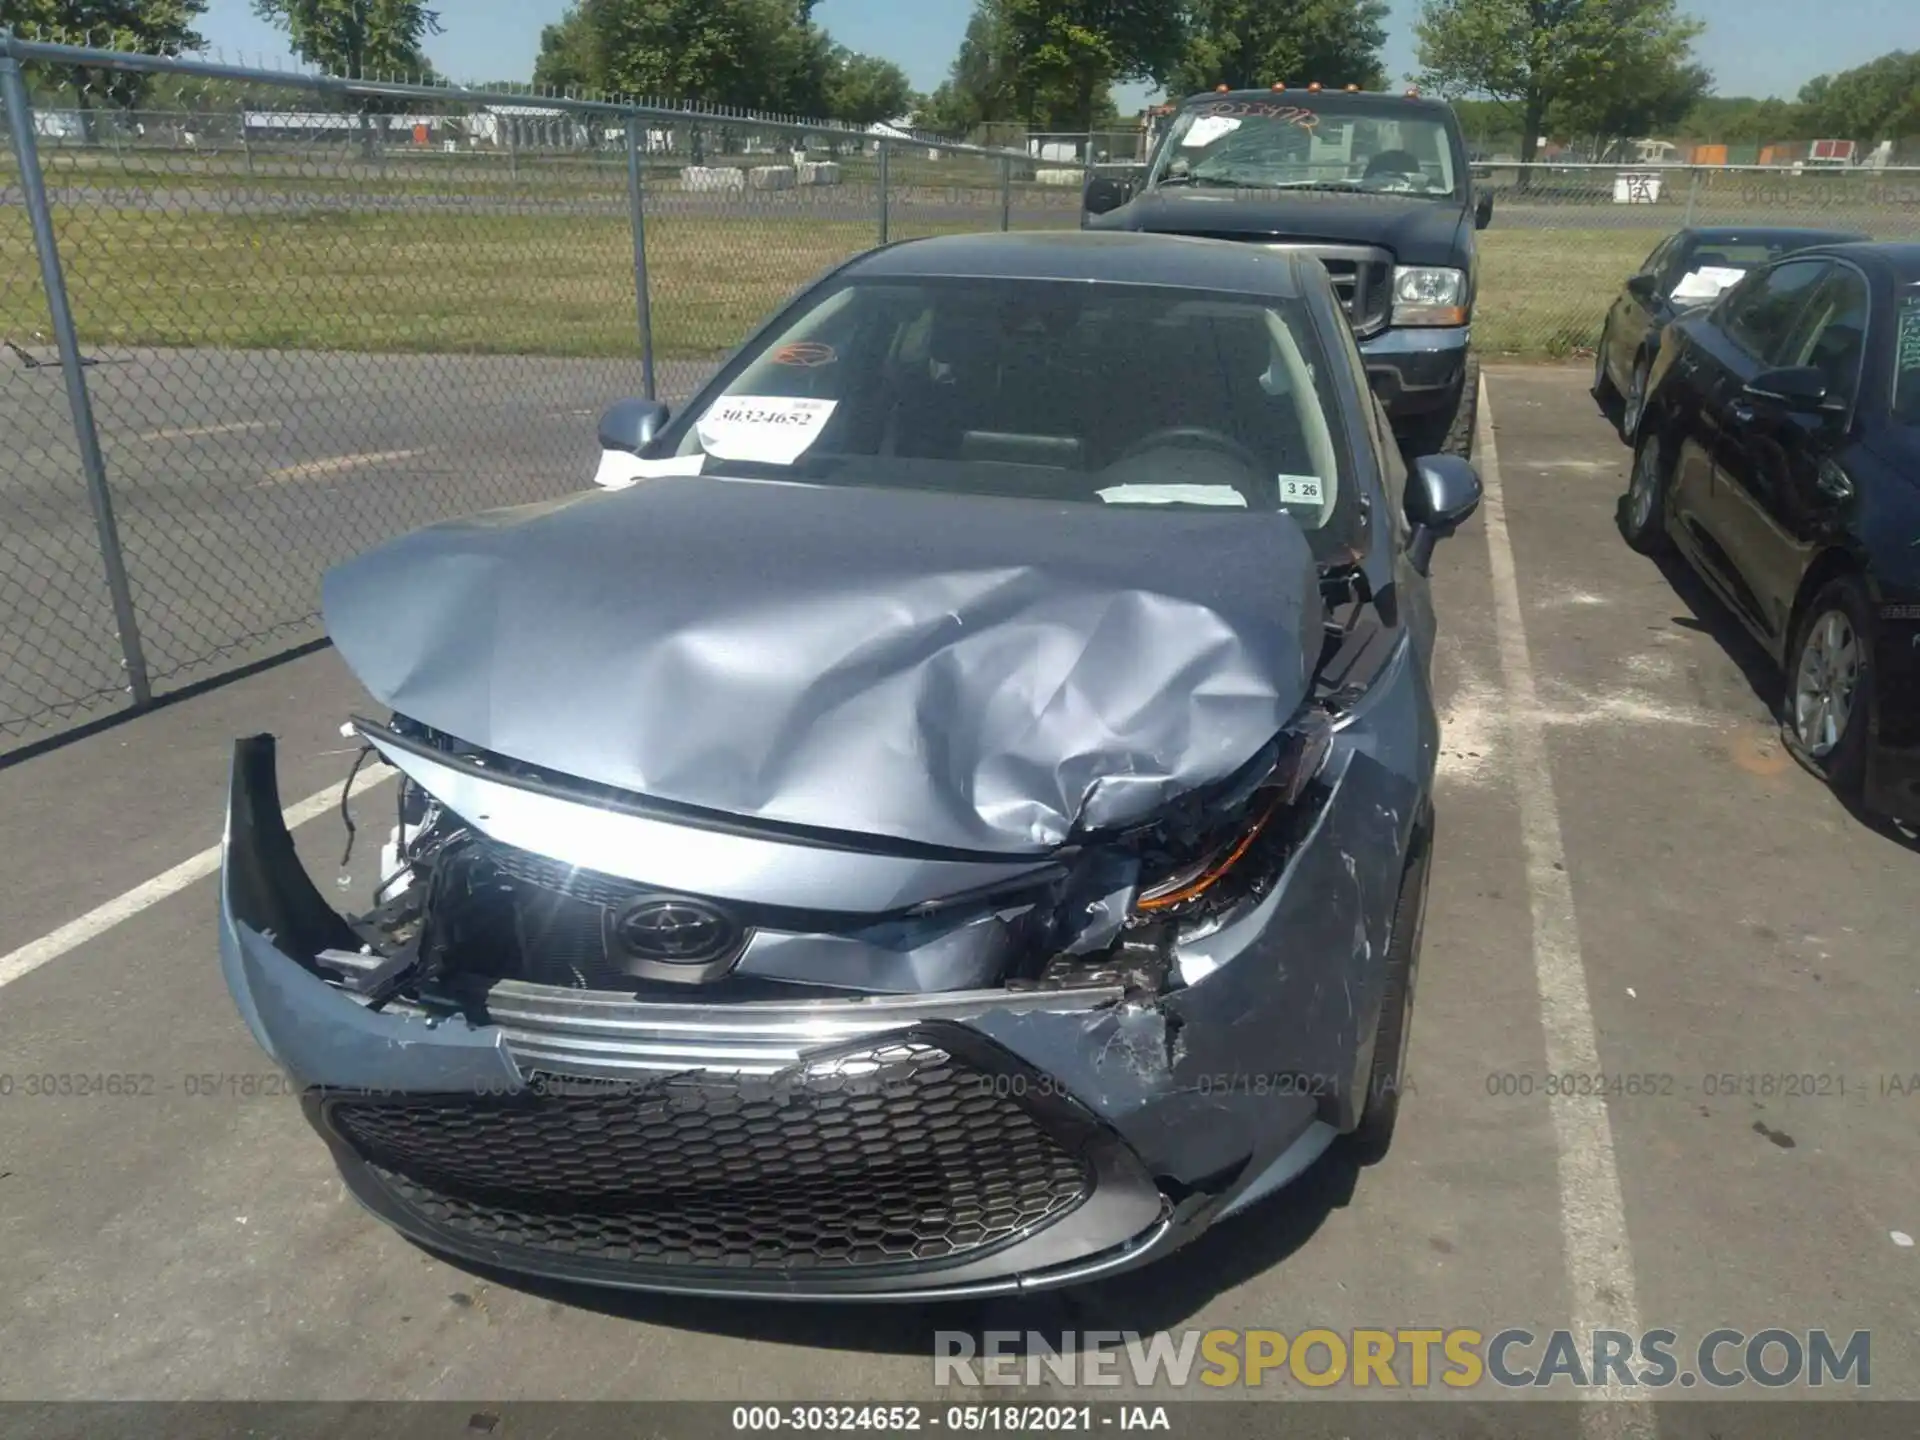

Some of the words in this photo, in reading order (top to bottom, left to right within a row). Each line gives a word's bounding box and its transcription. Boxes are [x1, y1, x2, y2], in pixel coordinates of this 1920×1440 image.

[714, 408, 812, 426] 30324652
[1287, 482, 1297, 494] 3
[1302, 484, 1317, 496] 26
